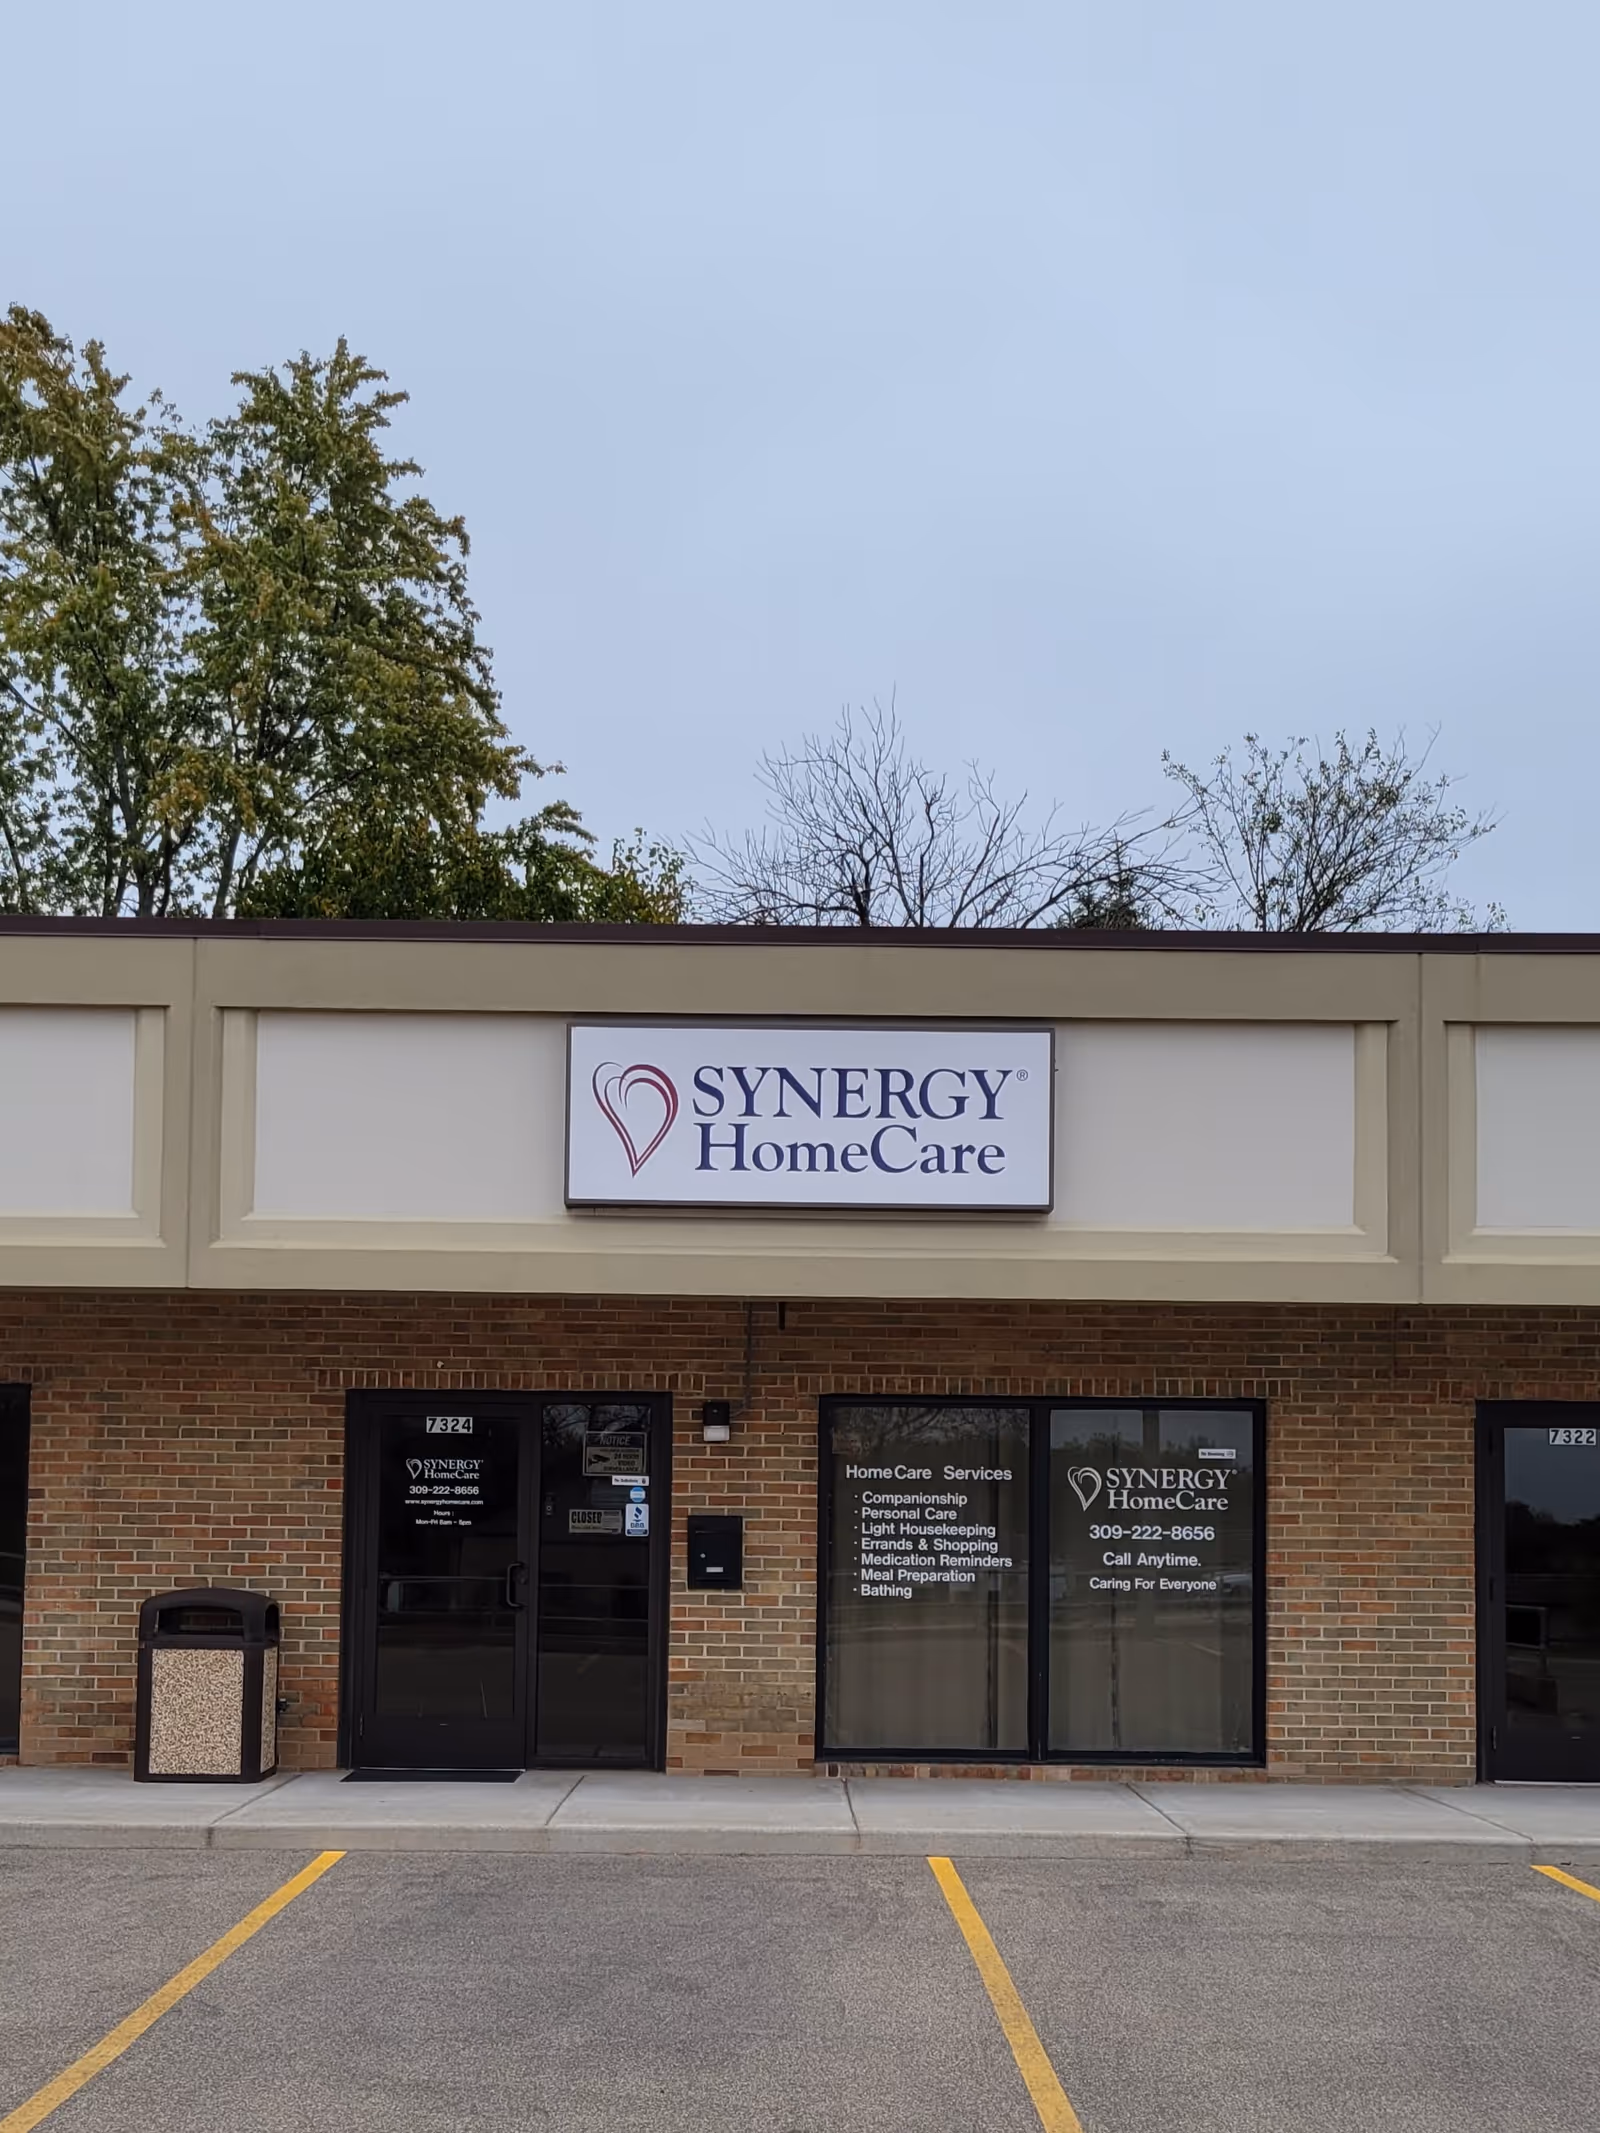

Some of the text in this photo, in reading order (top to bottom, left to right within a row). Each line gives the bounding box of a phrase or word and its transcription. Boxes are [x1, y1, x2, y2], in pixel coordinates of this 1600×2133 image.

[694, 1122, 1006, 1175] HomeCare
[428, 1418, 471, 1432] 7324
[600, 1435, 631, 1446] NOTICE
[1551, 1429, 1595, 1444] 7322
[424, 1469, 480, 1479] HomeCare
[943, 1466, 1013, 1481] Services
[409, 1486, 479, 1495] 309-222-8656
[862, 1491, 968, 1507] Companionship
[1107, 1489, 1229, 1510] HomeCare
[571, 1511, 603, 1524] CLOSED
[861, 1506, 958, 1520] Personal Care
[861, 1522, 996, 1539] Light Housekeeping
[1089, 1525, 1215, 1541] 309-222-8656
[861, 1538, 998, 1554] Errands & Shopping
[861, 1553, 1013, 1568] Medication Reminders
[1103, 1552, 1202, 1569] Call Anytime.
[861, 1569, 976, 1584] Meal Preparation
[861, 1584, 913, 1599] Bathing
[1089, 1577, 1217, 1592] Caring For Everyone
